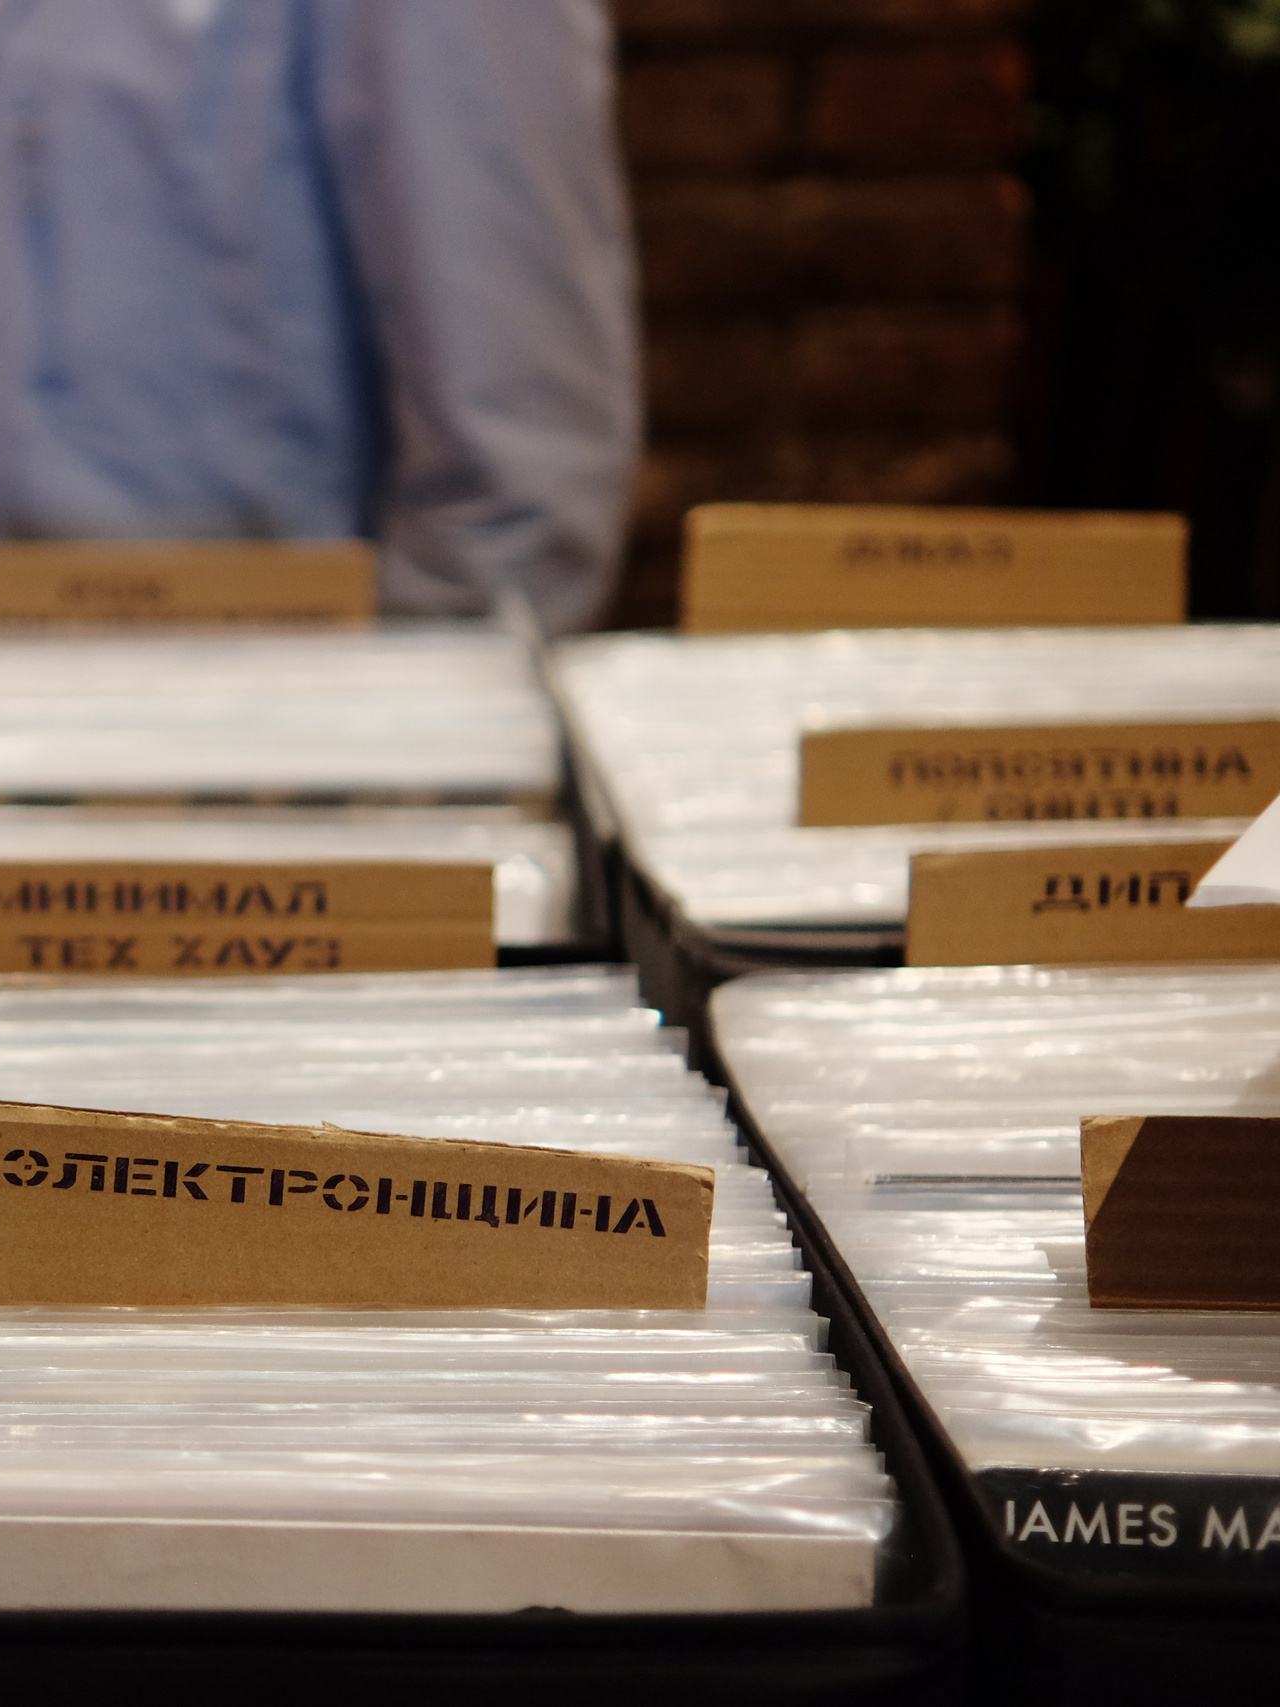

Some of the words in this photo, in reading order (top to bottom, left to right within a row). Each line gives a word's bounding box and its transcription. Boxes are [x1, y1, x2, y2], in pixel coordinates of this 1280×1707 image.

[888, 745, 1252, 788] ПОПСЯТИНА
[18, 935, 138, 969] ТЕХ
[171, 934, 342, 970] ХАУЗ
[1, 1148, 668, 1238] ЭЛЕКТРОНЩИНА
